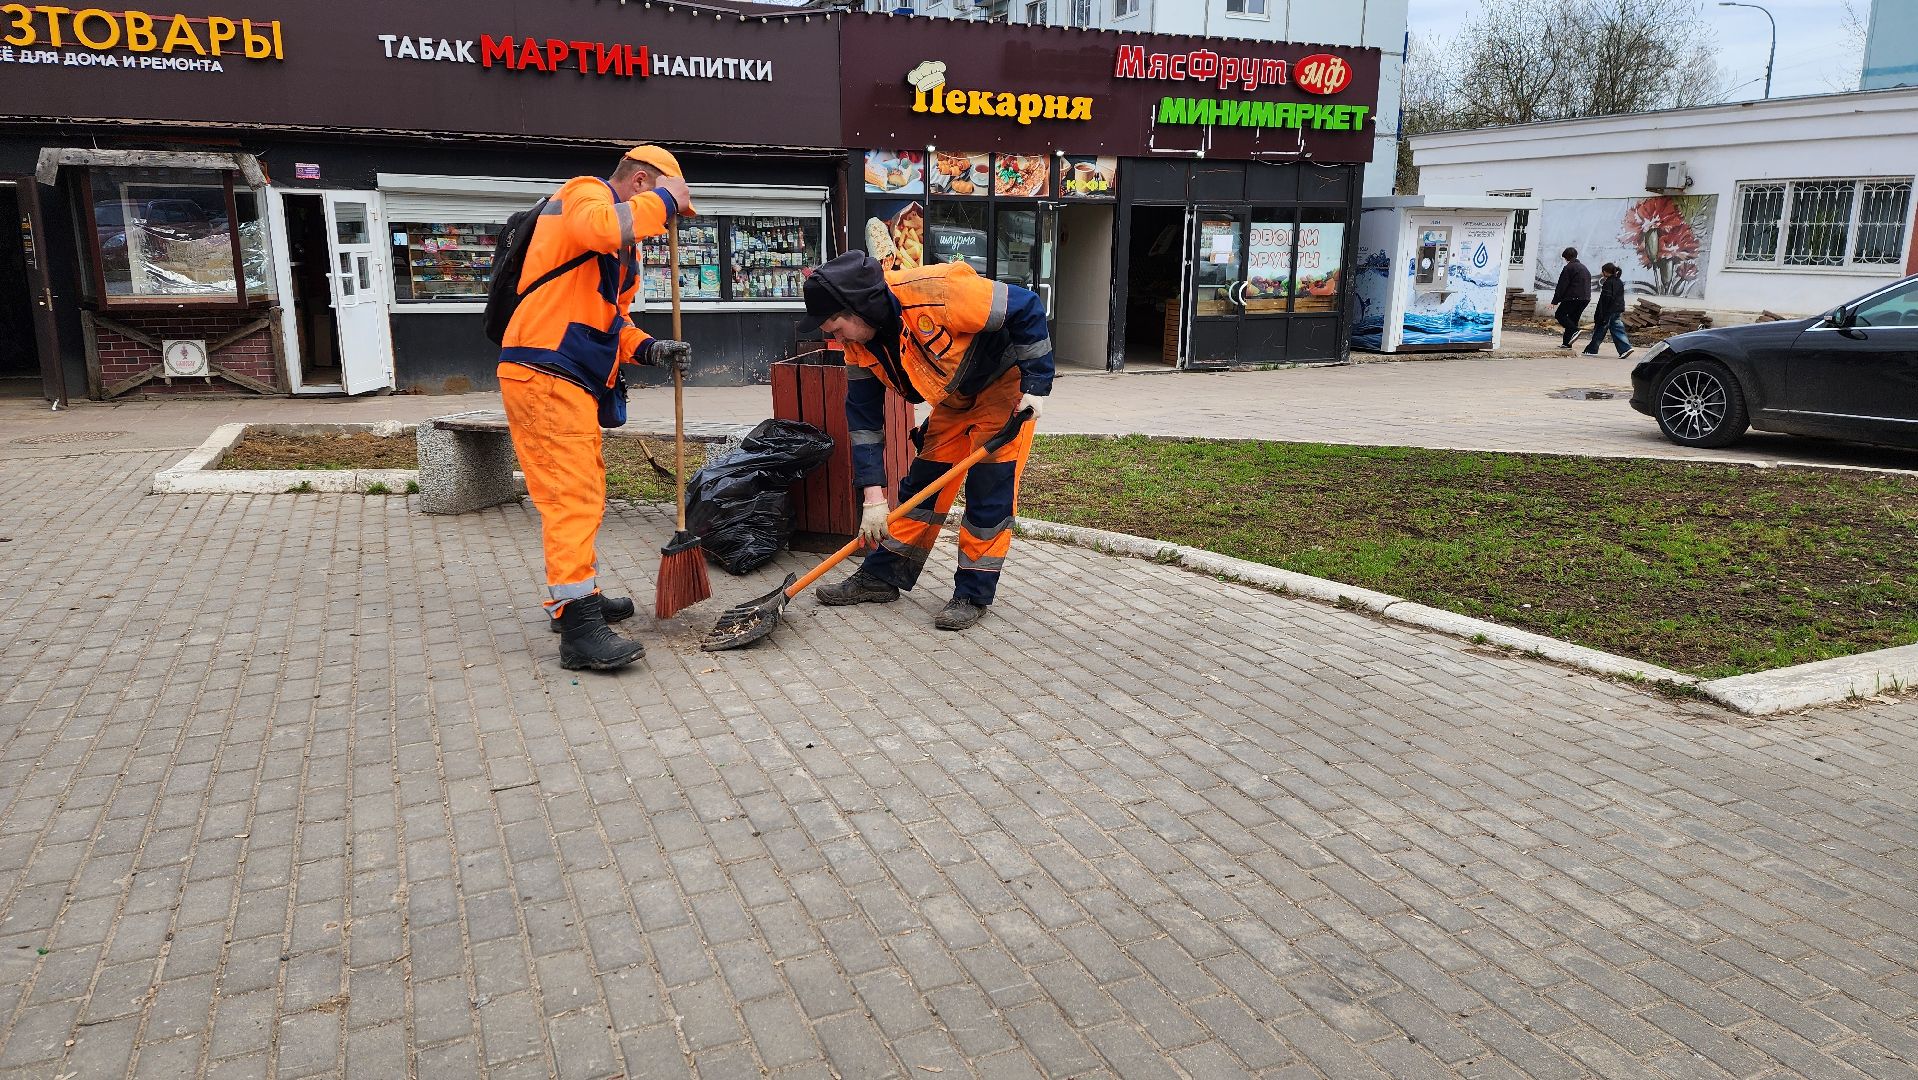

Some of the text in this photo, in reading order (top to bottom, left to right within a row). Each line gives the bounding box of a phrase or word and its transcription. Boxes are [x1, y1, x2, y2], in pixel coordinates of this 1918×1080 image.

[2, 3, 284, 60] ЗТОВАРЫ
[0, 46, 224, 73] Ё ДЛЯ ДОМА И РЕМОНТА
[378, 33, 773, 82] ТАБАК МАРТИН НАПИТКИ
[912, 80, 1094, 125] Пекарня
[1157, 96, 1370, 131] МИНИМАРКЕТ
[1066, 179, 1108, 192] КОФЕ
